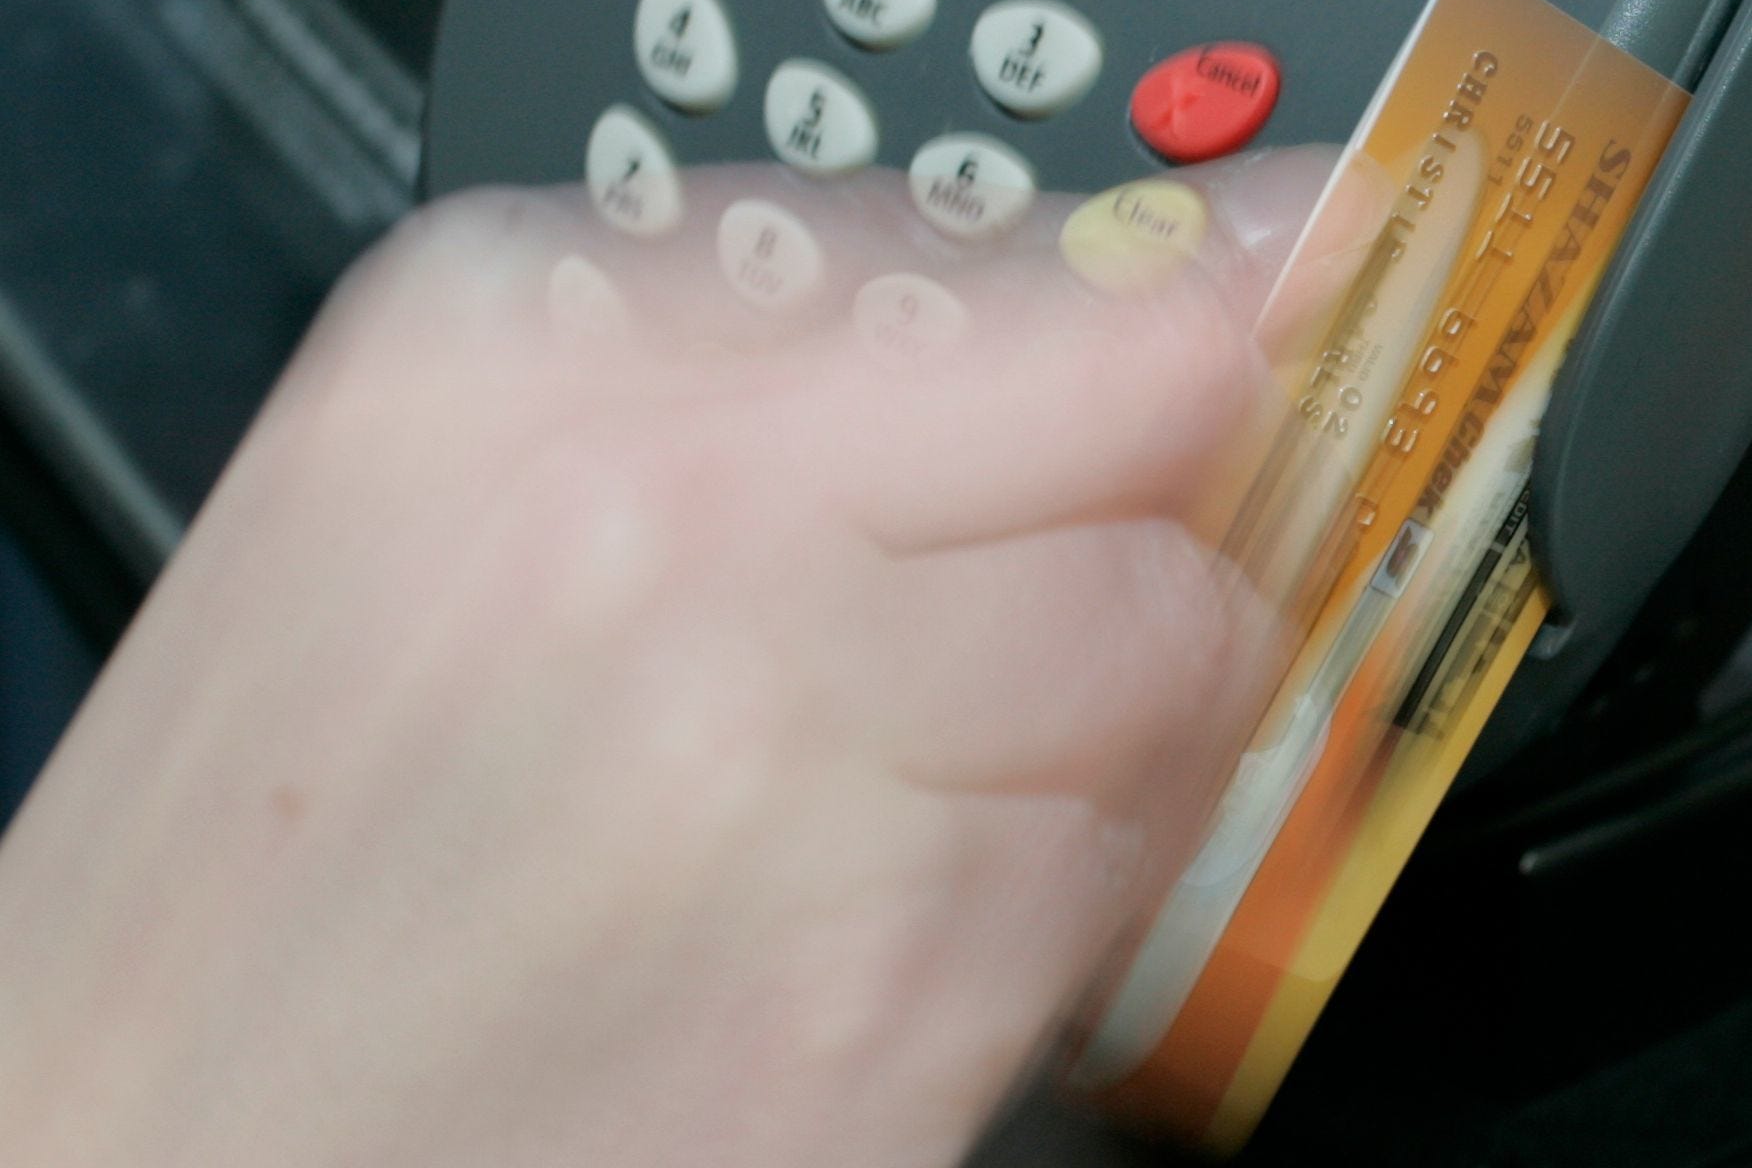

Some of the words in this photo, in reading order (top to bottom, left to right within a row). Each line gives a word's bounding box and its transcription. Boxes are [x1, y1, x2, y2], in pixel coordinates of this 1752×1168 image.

[668, 2, 692, 38] 4
[1019, 22, 1045, 58] 3
[998, 56, 1047, 95] DEF
[1196, 45, 1264, 99] Cancel
[806, 88, 827, 129] 5
[956, 151, 980, 185] 6
[1487, 112, 1535, 186] 5511
[925, 178, 987, 223] MNO
[1474, 118, 1576, 261] 5511
[1113, 188, 1179, 240] Clear
